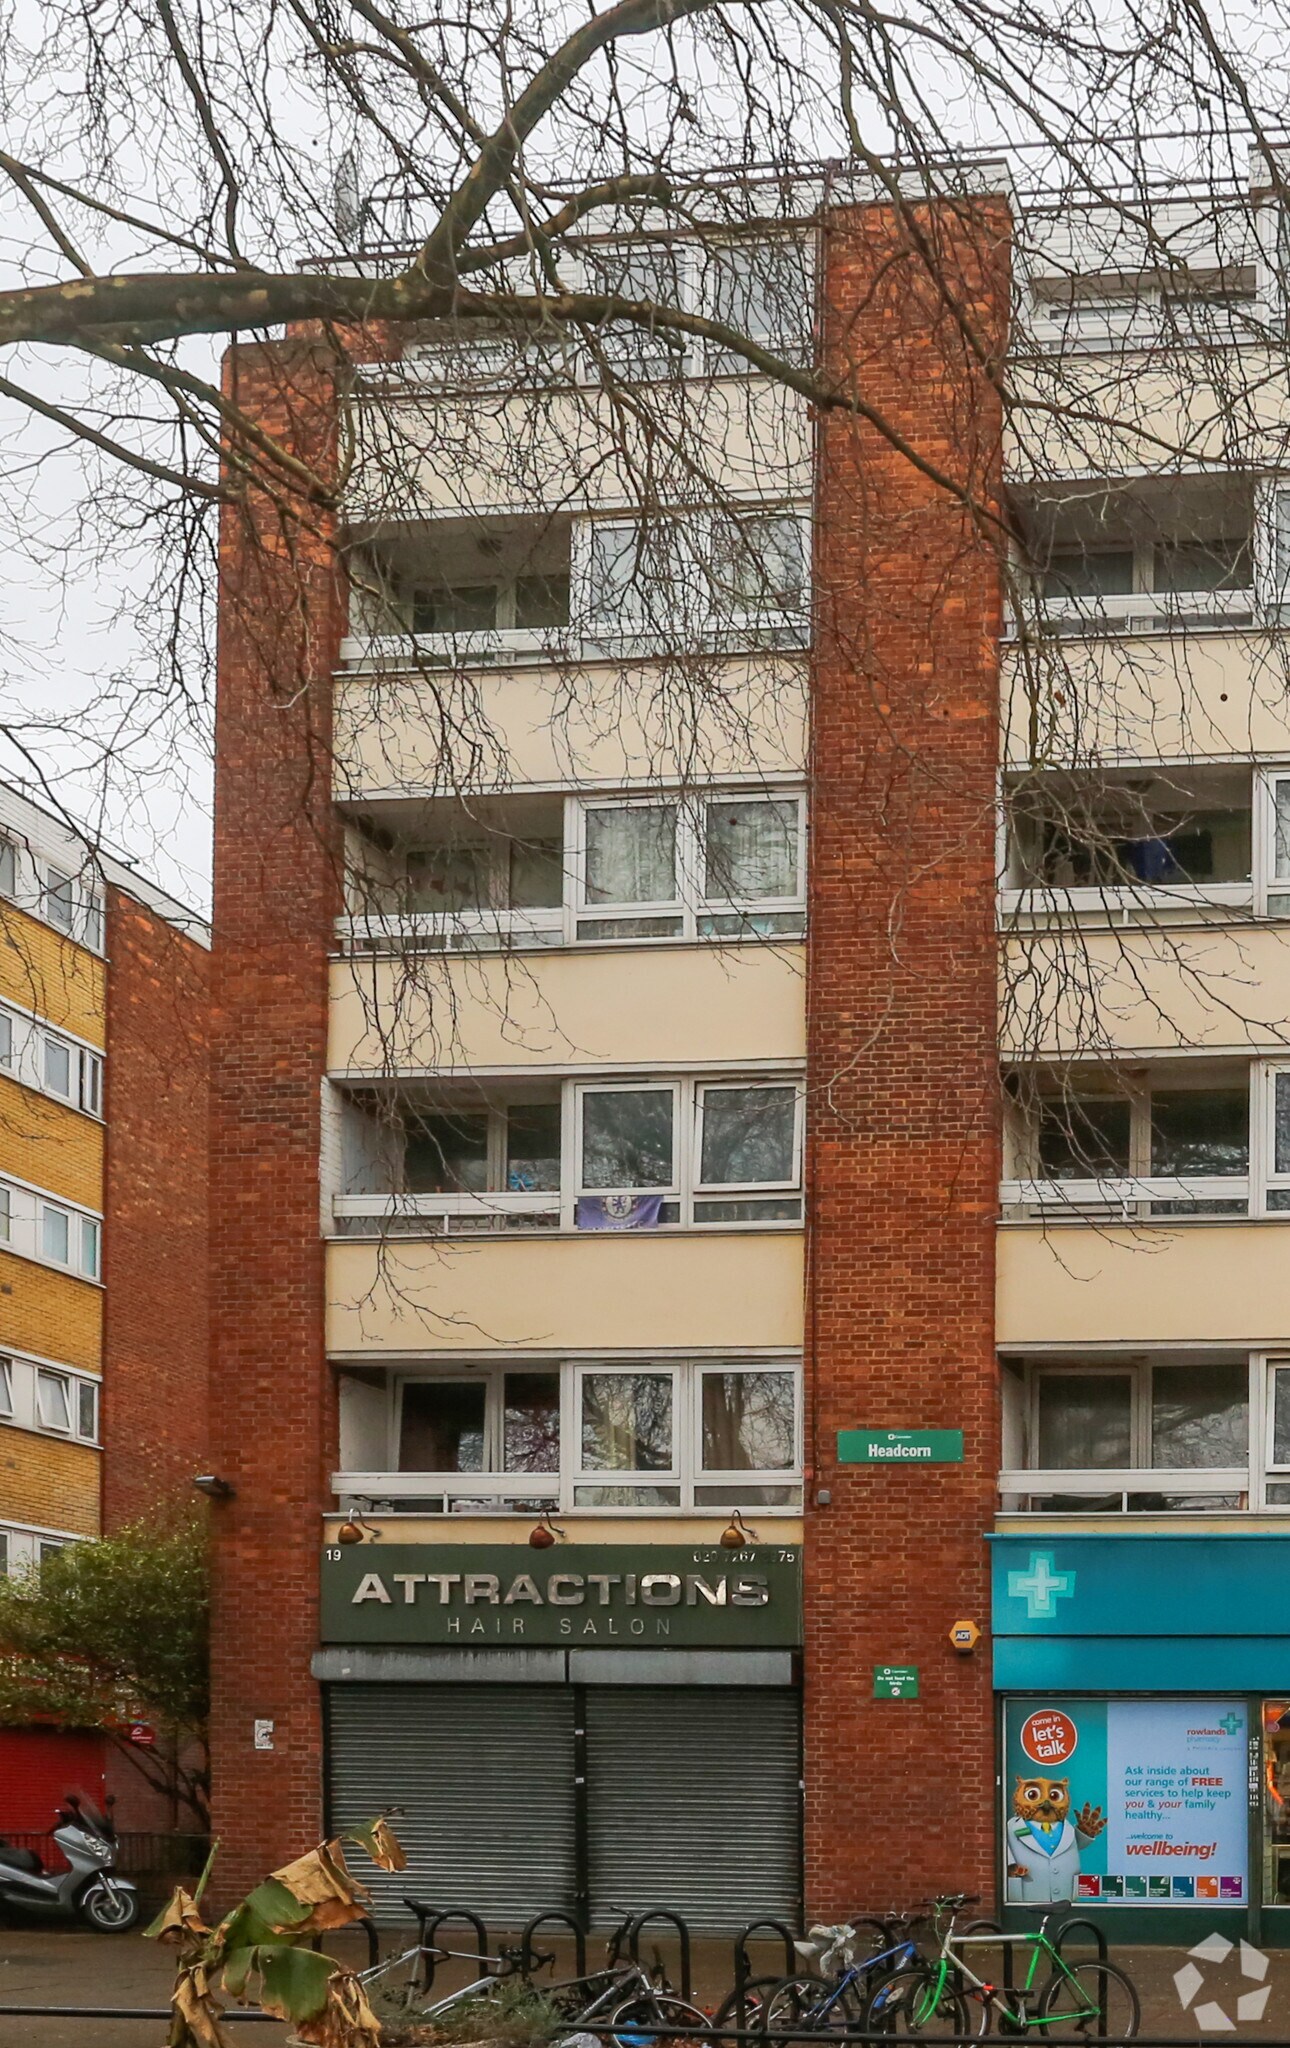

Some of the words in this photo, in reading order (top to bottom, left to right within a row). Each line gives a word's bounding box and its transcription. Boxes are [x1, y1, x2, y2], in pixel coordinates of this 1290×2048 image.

[868, 1443, 932, 1458] Headcorn
[326, 1549, 342, 1561] 19
[351, 1573, 770, 1607] ATTRACTIONS
[447, 1617, 525, 1635] HAIR
[559, 1618, 671, 1636] SALON
[1031, 1717, 1052, 1726] come
[1052, 1714, 1061, 1723] in
[1032, 1724, 1065, 1742] let's
[1187, 1728, 1226, 1736] rowlands
[1036, 1739, 1066, 1757] talk
[1125, 1766, 1143, 1775] Ask
[1147, 1766, 1176, 1775] inside
[1180, 1766, 1209, 1775] about
[1145, 1779, 1174, 1788] range
[1178, 1777, 1188, 1786] of
[1191, 1777, 1223, 1786] FREE
[1125, 1788, 1164, 1797] services
[1168, 1789, 1178, 1797] to
[1181, 1788, 1203, 1799] help
[1206, 1788, 1231, 1799] keep
[1125, 1801, 1144, 1810] you
[1147, 1800, 1155, 1808] &
[1158, 1801, 1182, 1810] your
[1185, 1800, 1216, 1811] family
[1126, 1841, 1217, 1860] wellbeing!
